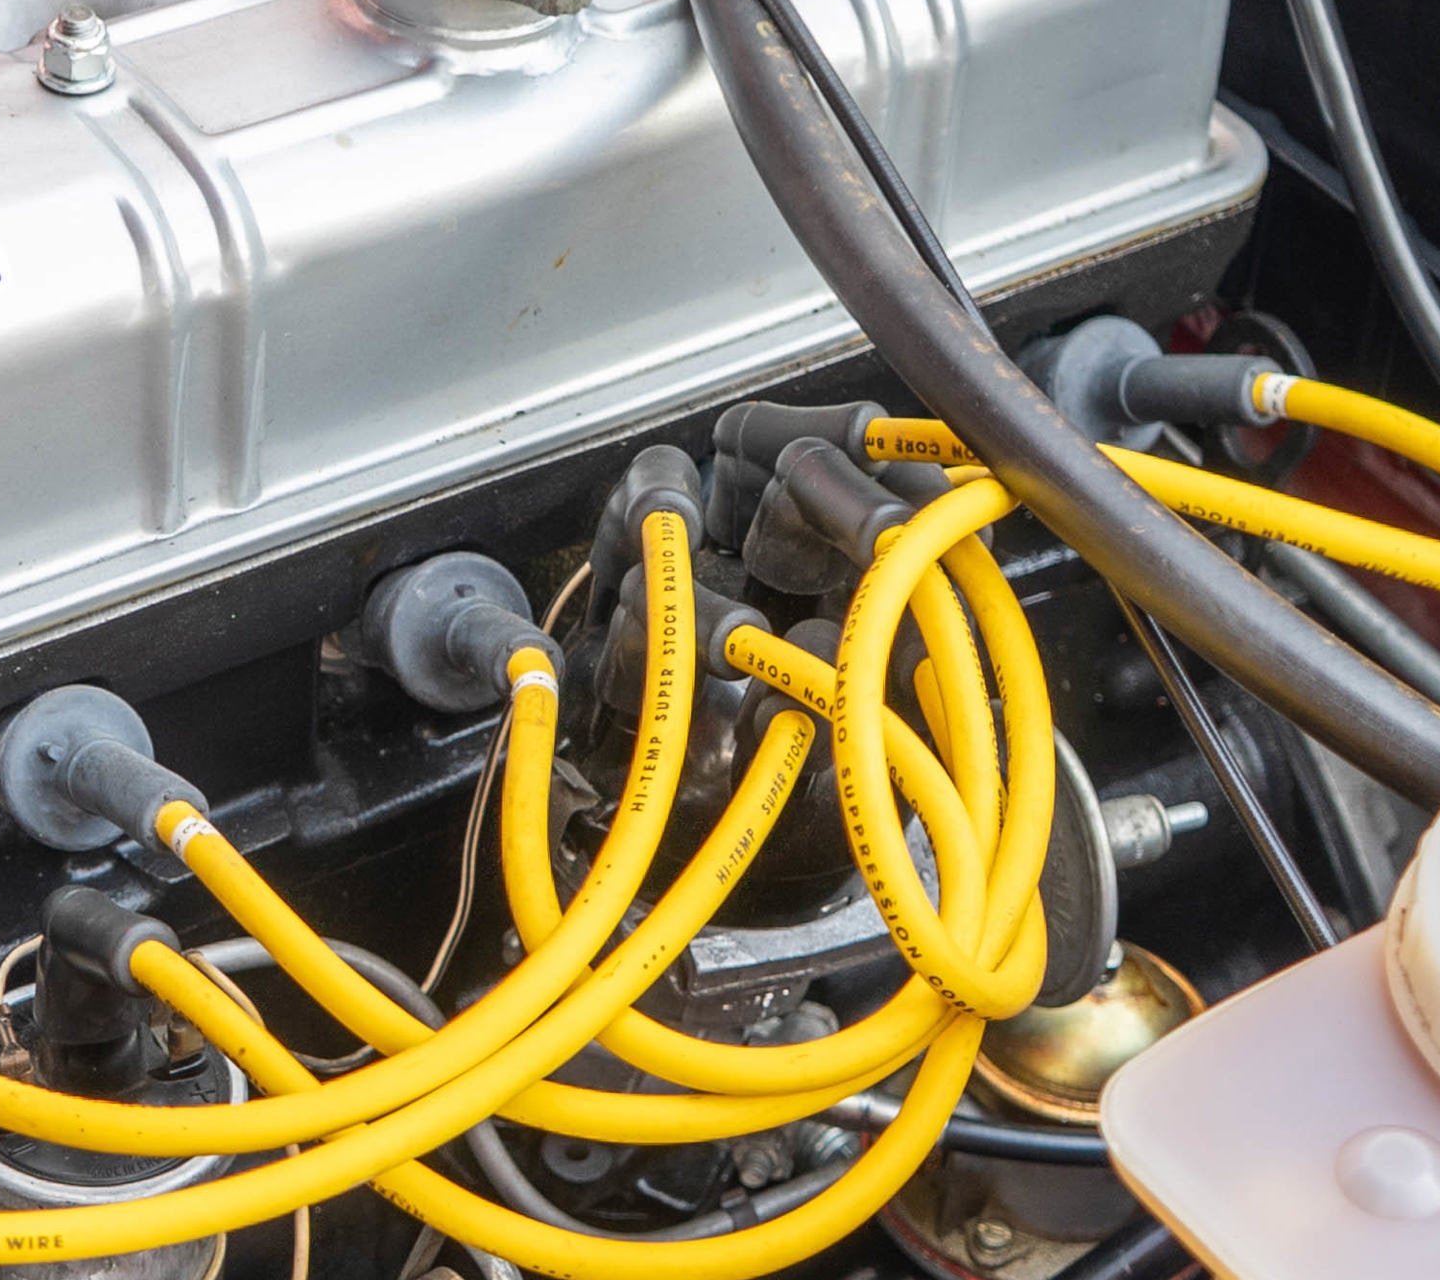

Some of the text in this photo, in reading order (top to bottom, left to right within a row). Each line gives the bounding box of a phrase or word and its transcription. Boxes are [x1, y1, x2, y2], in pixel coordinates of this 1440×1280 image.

[894, 435, 941, 456] CORE
[662, 548, 677, 594] RADIO
[661, 604, 678, 656] STOCK
[653, 668, 674, 722] SUPER
[747, 652, 792, 686] CORE
[834, 662, 849, 745] RADIO
[630, 735, 663, 813] HI-TEMP
[717, 726, 809, 886] HI-TEMP SUPER STOCK
[840, 767, 923, 960] SUPPRESSION
[6, 1234, 65, 1251] WIRE
